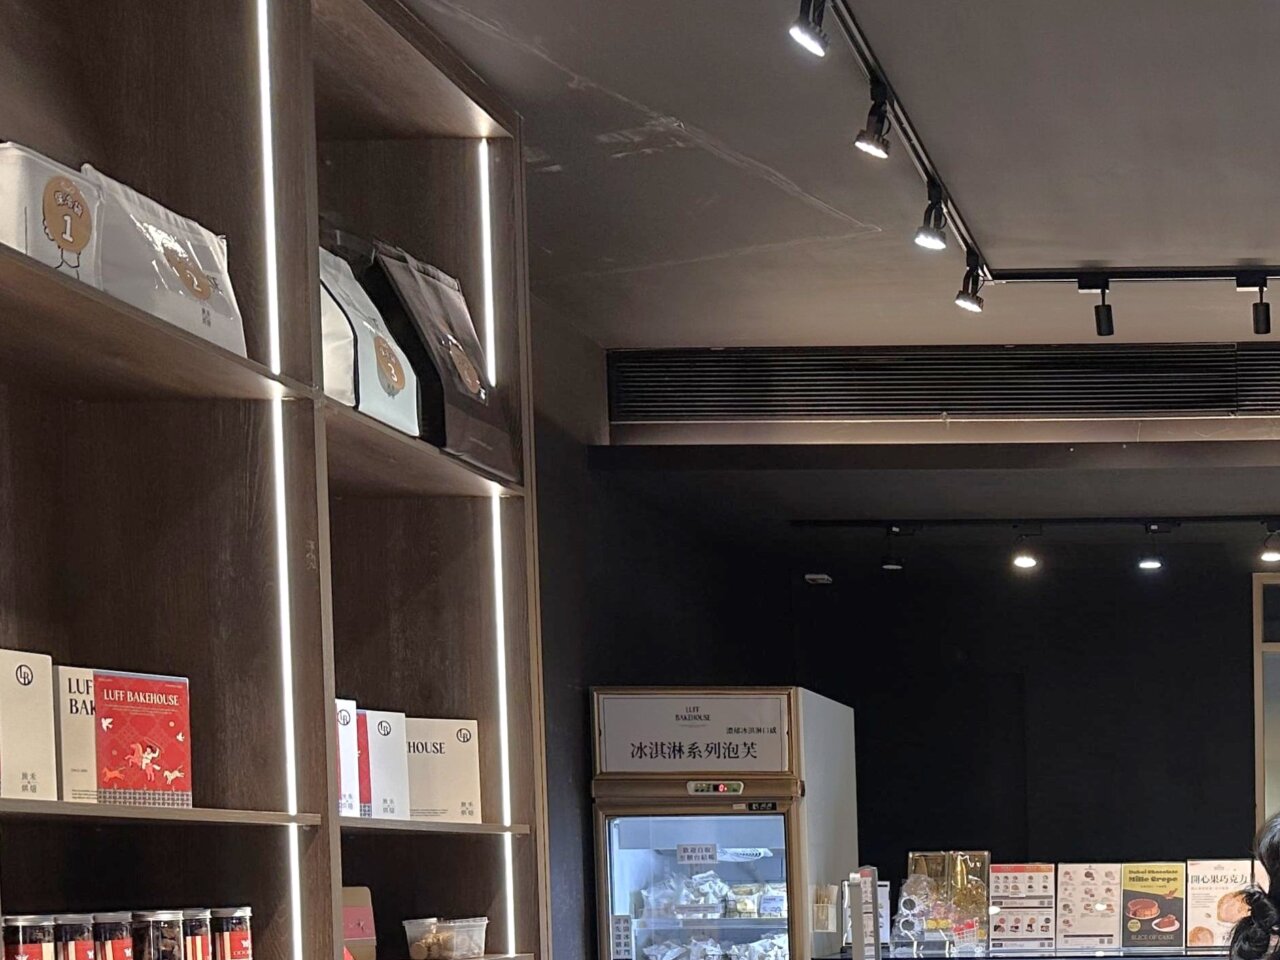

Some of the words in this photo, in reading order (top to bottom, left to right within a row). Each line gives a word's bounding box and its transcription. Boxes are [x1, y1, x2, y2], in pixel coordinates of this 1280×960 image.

[68, 677, 94, 696] LUF
[69, 698, 96, 716] BAK
[103, 689, 126, 702] LUFF
[127, 691, 180, 707] BAKEHOUSE
[407, 741, 446, 754] HOUSE
[630, 741, 758, 759] 冰淇淋系列泡芙
[1191, 874, 1248, 884] 開心果巧克力
